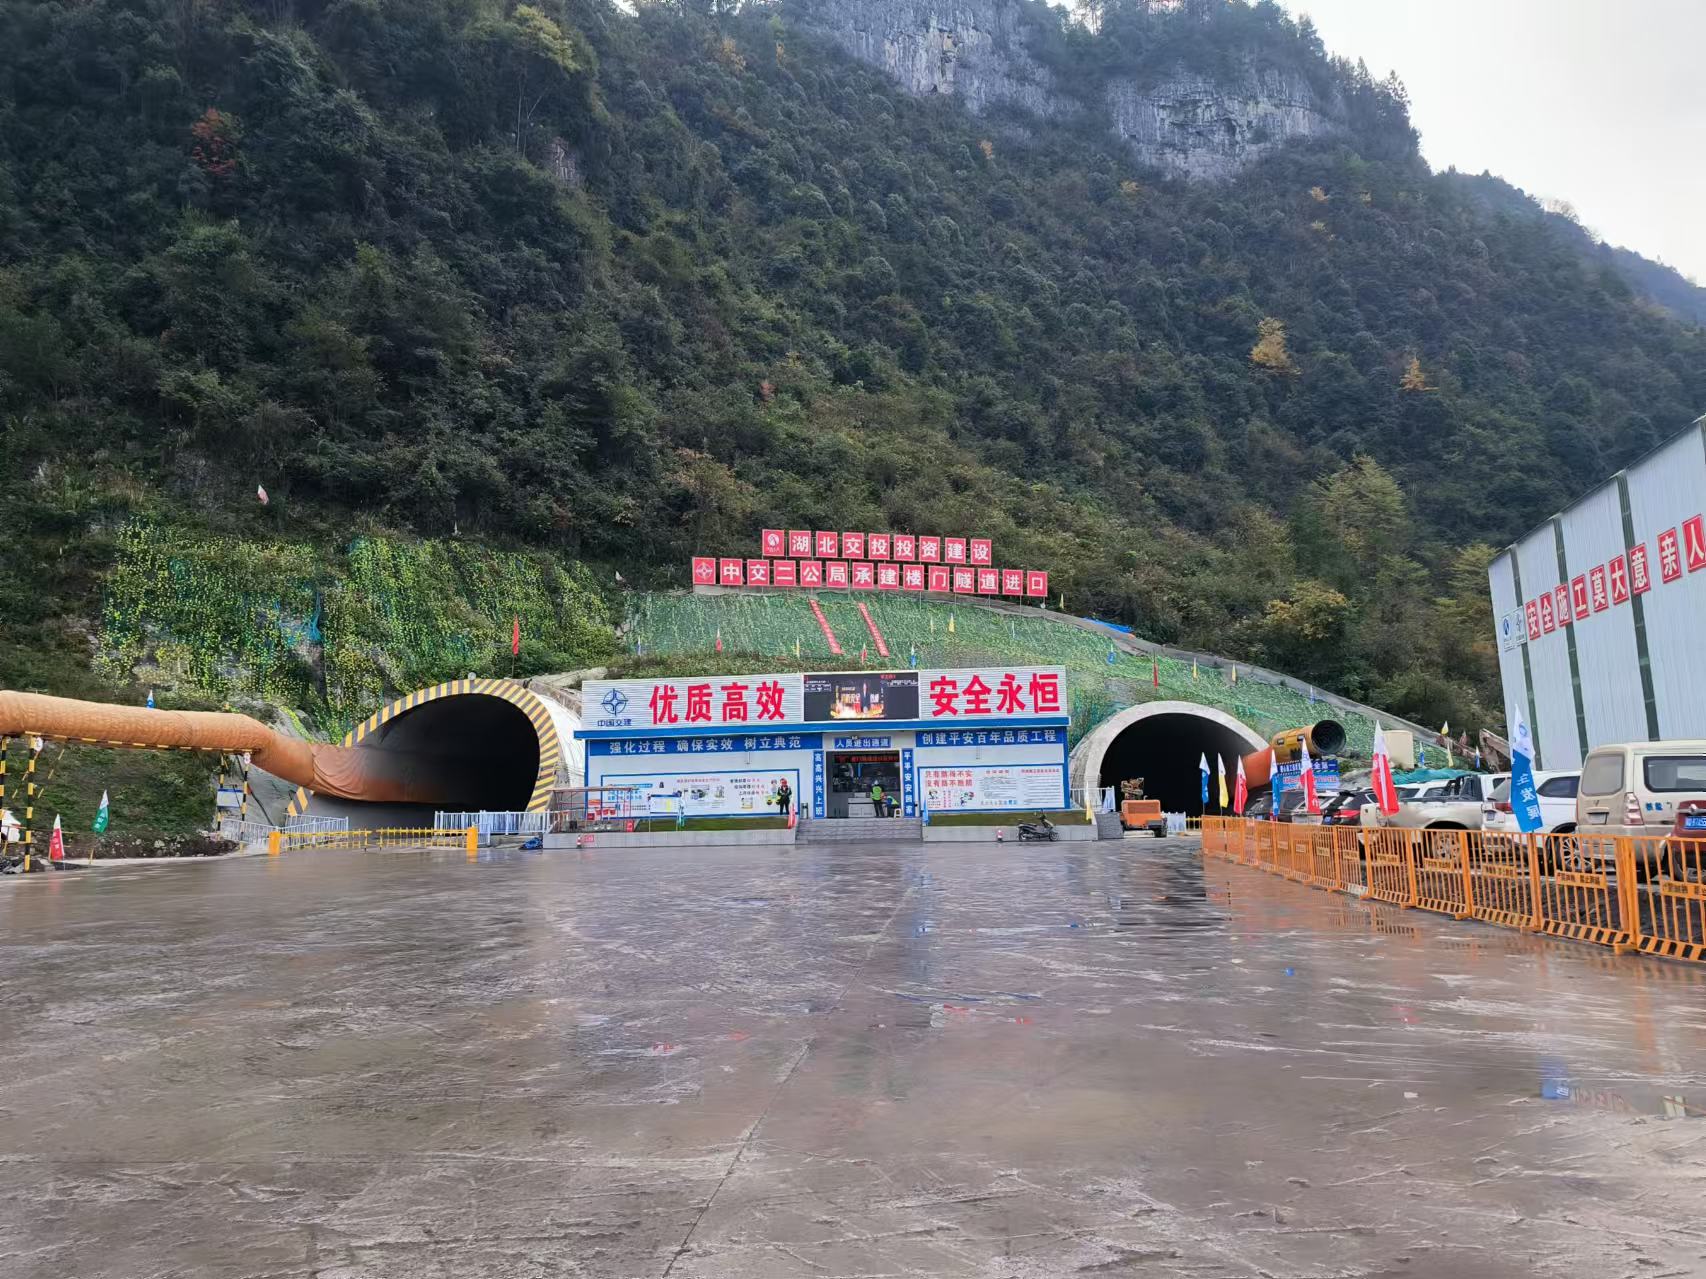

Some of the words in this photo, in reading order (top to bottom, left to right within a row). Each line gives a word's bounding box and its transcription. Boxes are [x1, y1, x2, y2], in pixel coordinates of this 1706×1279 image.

[791, 532, 990, 563] 湖北交投投资建设
[722, 561, 1046, 593] 中交二公局承建楼门隧道进口
[1527, 547, 1648, 637] 安全施工莫大意
[648, 680, 785, 725] 优质高效
[929, 673, 1061, 717] 安全永恒
[597, 718, 632, 727] 中国交建
[922, 730, 1057, 746] 创建平安百年品质工程
[609, 740, 666, 754] 强化过程
[676, 738, 734, 752] 确保实效
[743, 736, 802, 750] 树立典范
[836, 738, 889, 748] 人员进出通道
[814, 753, 823, 816] 高高兴兴上班
[904, 751, 913, 816] 平平安安回家
